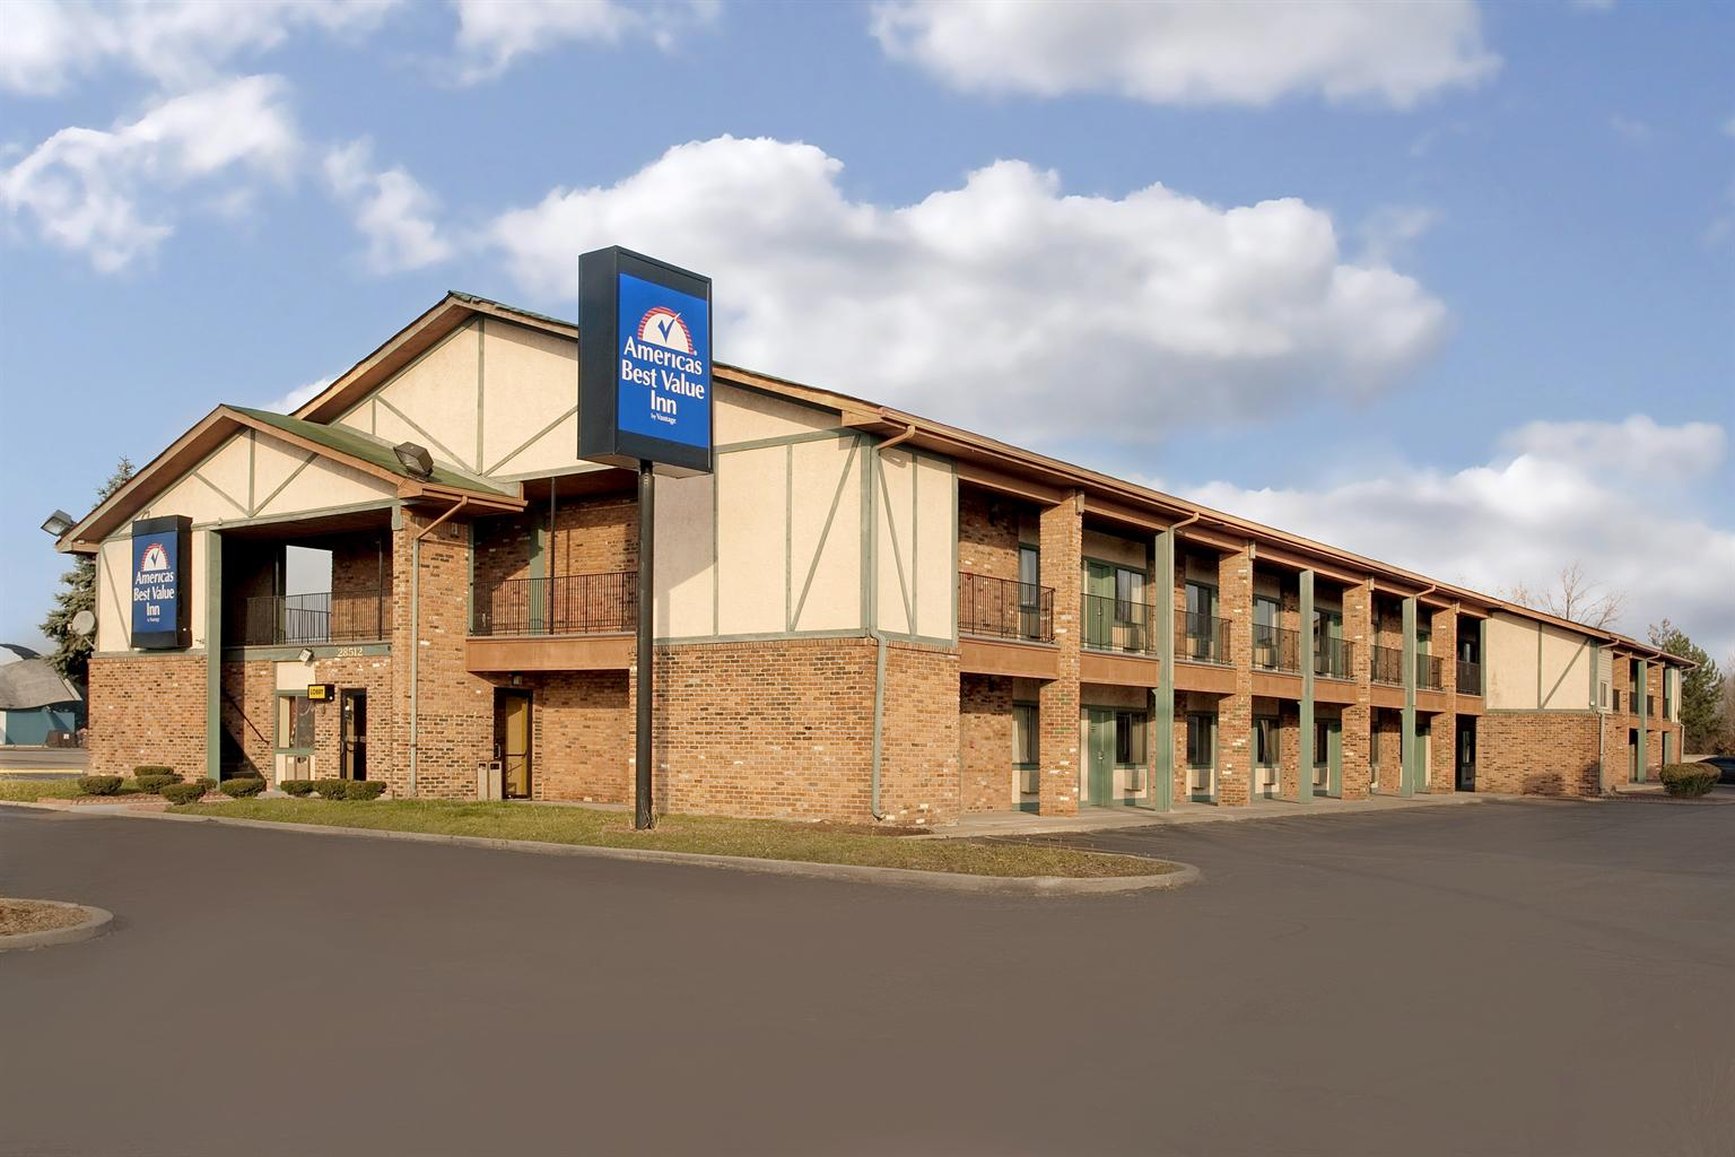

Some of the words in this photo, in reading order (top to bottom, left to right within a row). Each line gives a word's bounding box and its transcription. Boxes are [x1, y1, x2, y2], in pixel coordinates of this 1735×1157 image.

[624, 336, 702, 375] Americas
[622, 359, 657, 388] Best
[661, 370, 705, 399] Value
[651, 390, 677, 415] Inn
[135, 571, 174, 585] Americas
[134, 587, 150, 601] Best
[152, 585, 175, 600] Value
[147, 602, 160, 616] Inn
[337, 647, 363, 657] 28512
